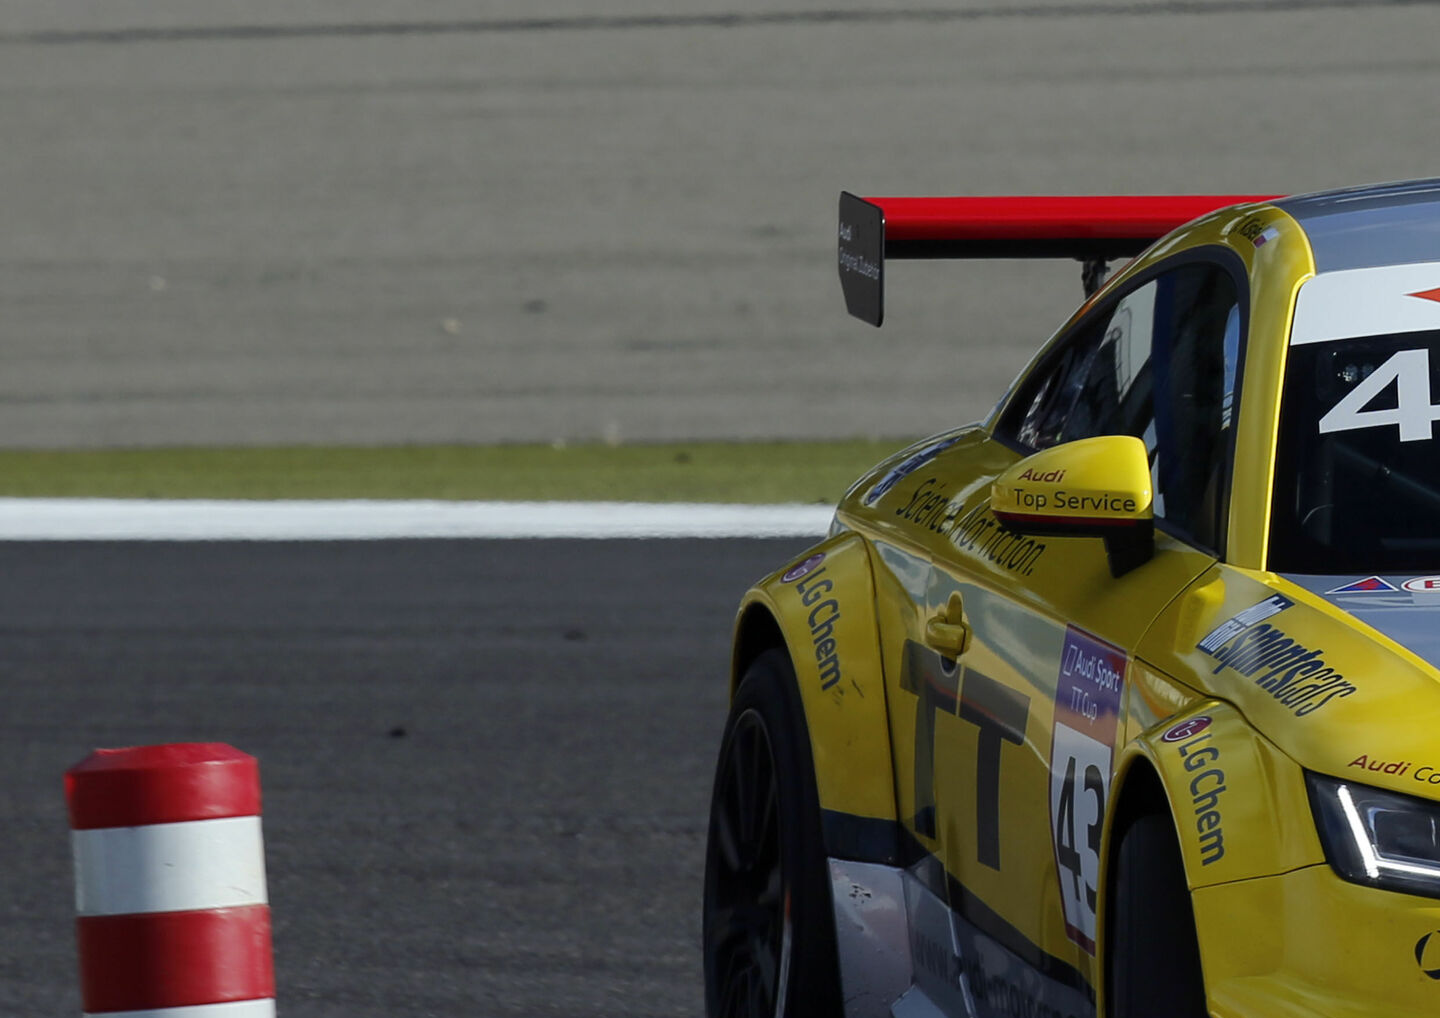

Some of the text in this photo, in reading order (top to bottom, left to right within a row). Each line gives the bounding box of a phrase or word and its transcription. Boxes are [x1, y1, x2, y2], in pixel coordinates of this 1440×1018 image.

[1017, 468, 1067, 483] Audi
[1014, 488, 1137, 512] Top Service
[796, 567, 841, 691] LG Chem
[1074, 650, 1120, 692] Audi Sport
[1082, 692, 1098, 726] Cup
[1348, 754, 1412, 776] Audi
[1178, 733, 1227, 867] LG Chem
